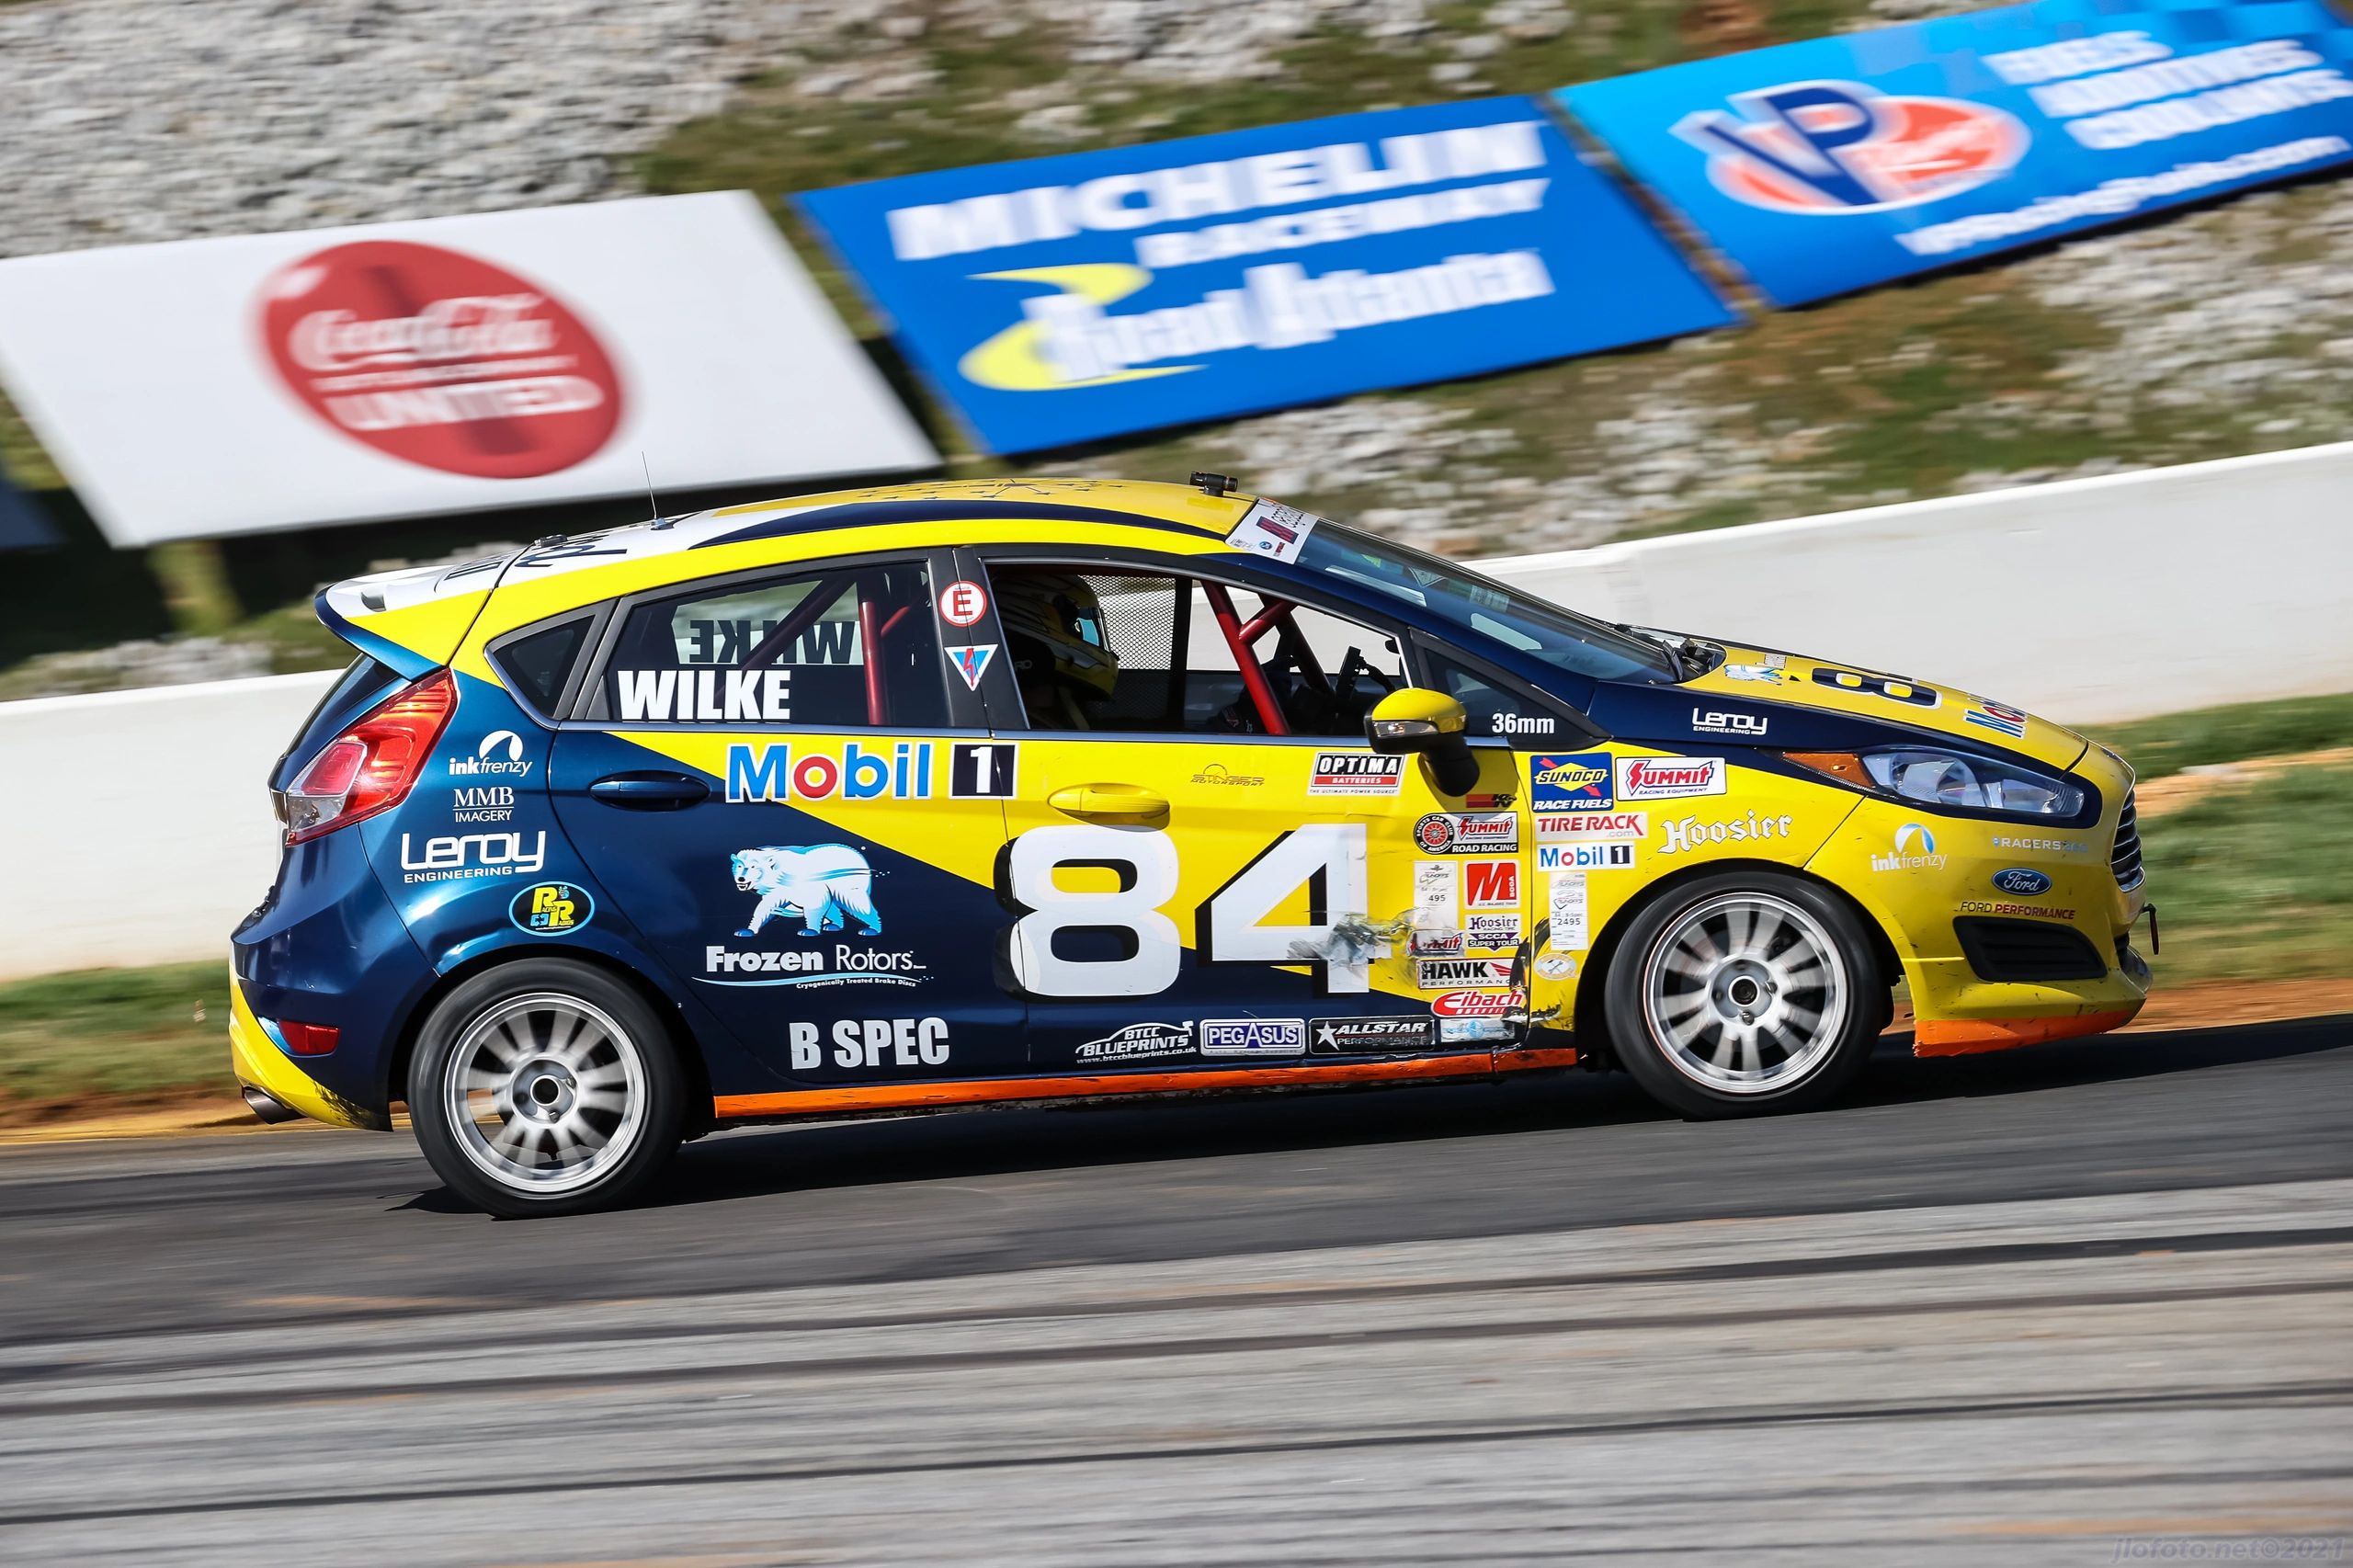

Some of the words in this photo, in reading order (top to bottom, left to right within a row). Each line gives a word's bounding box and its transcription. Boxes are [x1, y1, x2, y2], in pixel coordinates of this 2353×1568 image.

[886, 120, 1548, 261] MICHELIN
[953, 590, 972, 616] E
[618, 670, 791, 720] WILKE
[1492, 712, 1554, 733] 36mm
[1693, 708, 1768, 734] Leroy
[1693, 726, 1750, 734] ENGINEERING
[449, 756, 533, 778] inkfrenzy
[725, 743, 935, 802] Mobil
[1319, 756, 1397, 774] OPTIMA
[1540, 769, 1605, 783] SUNOCO
[1626, 760, 1713, 794] Summit
[453, 786, 515, 807] MMB
[1533, 799, 1571, 811] RACE
[1571, 798, 1613, 809] FUELS
[455, 810, 512, 823] IMAGERY
[1538, 816, 1583, 833] TIRE
[1586, 814, 1644, 835] RACK
[1458, 816, 1513, 839] Summit
[1657, 809, 1793, 854] Hoosier
[401, 830, 546, 873] Leroy
[1452, 845, 1480, 853] ROAD
[1481, 844, 1517, 852] RACING
[1540, 846, 1604, 867] Mobil
[1870, 851, 1948, 872] inkfrenzy
[404, 867, 513, 883] ENGINEERING
[2004, 870, 2040, 892] Ford
[1008, 824, 1391, 996] 84
[1960, 902, 1993, 913] FORD
[1994, 903, 2075, 920] PERFORMANCE
[1469, 915, 1518, 930] Hoosier
[706, 945, 824, 972] Frozen
[835, 944, 914, 971] Rotors
[1421, 961, 1489, 980] HAWK
[796, 978, 845, 989] Cryogenically
[875, 977, 896, 985] Brake
[898, 979, 916, 987] Discs
[1433, 990, 1523, 1015] Eibach
[1124, 1026, 1161, 1040] BTCC
[1209, 1022, 1298, 1047] PEGASUS
[1336, 1022, 1427, 1035] ALLSTAR
[789, 1022, 821, 1070] B
[832, 1017, 949, 1067] SPEC
[1083, 1034, 1189, 1057] BLUEPRINTS
[1076, 1046, 1197, 1063] www.btccblueprints.co.uk
